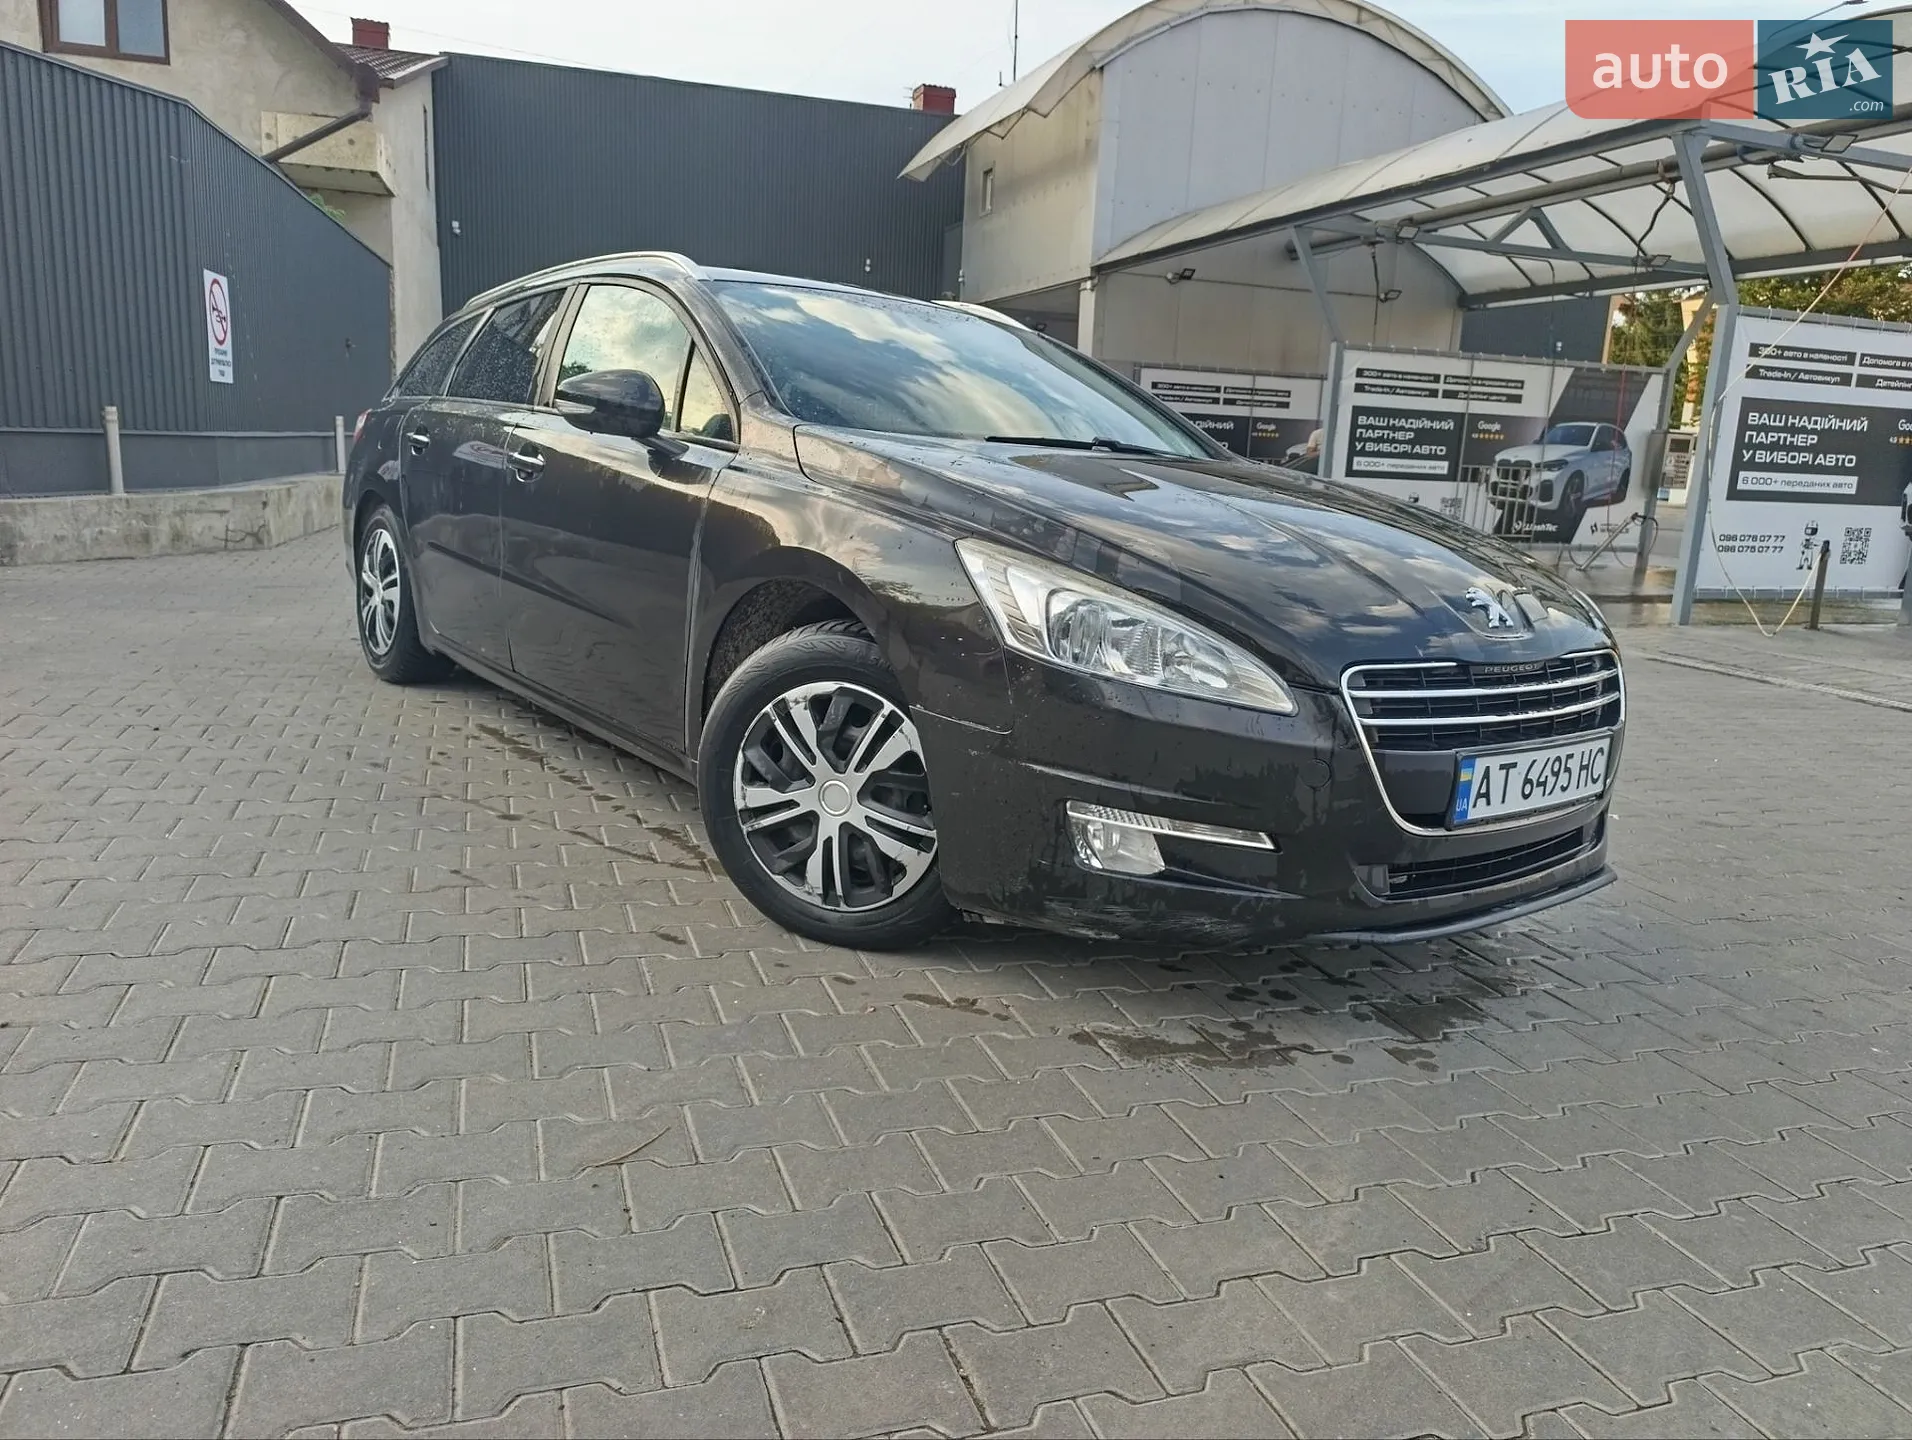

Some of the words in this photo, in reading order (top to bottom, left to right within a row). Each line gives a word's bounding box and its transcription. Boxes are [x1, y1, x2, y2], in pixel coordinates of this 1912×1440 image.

[1783, 350, 1802, 359] авто
[1809, 353, 1847, 361] наявності
[1862, 356, 1901, 367] Допомога
[1798, 371, 1841, 384] Автовикуп
[1357, 415, 1388, 426] ВАШ
[1389, 417, 1454, 431] НАДІЙНИЙ
[1477, 420, 1501, 432] Google
[1747, 412, 1786, 427] ВАШ
[1787, 414, 1869, 432] НАДІЙНИЙ
[1356, 428, 1414, 440] ПАРТНЕР
[1744, 431, 1818, 446] ПАРТНЕР
[1355, 441, 1364, 451] У
[1364, 442, 1412, 453] ВИБОРІ
[1412, 445, 1446, 455] АВТО
[1742, 449, 1753, 463] У
[1754, 450, 1813, 465] ВИБОРІ
[1814, 453, 1856, 468] АВТО
[1742, 476, 1749, 485] 6
[1750, 476, 1779, 486] 000+
[1780, 479, 1830, 489] переданих
[1773, 535, 1785, 543] 77
[1484, 664, 1540, 674] PEUGEOT
[1472, 761, 1518, 809] AT
[1521, 753, 1572, 799] 6495
[1576, 747, 1605, 790] HC
[1456, 797, 1468, 812] UA
